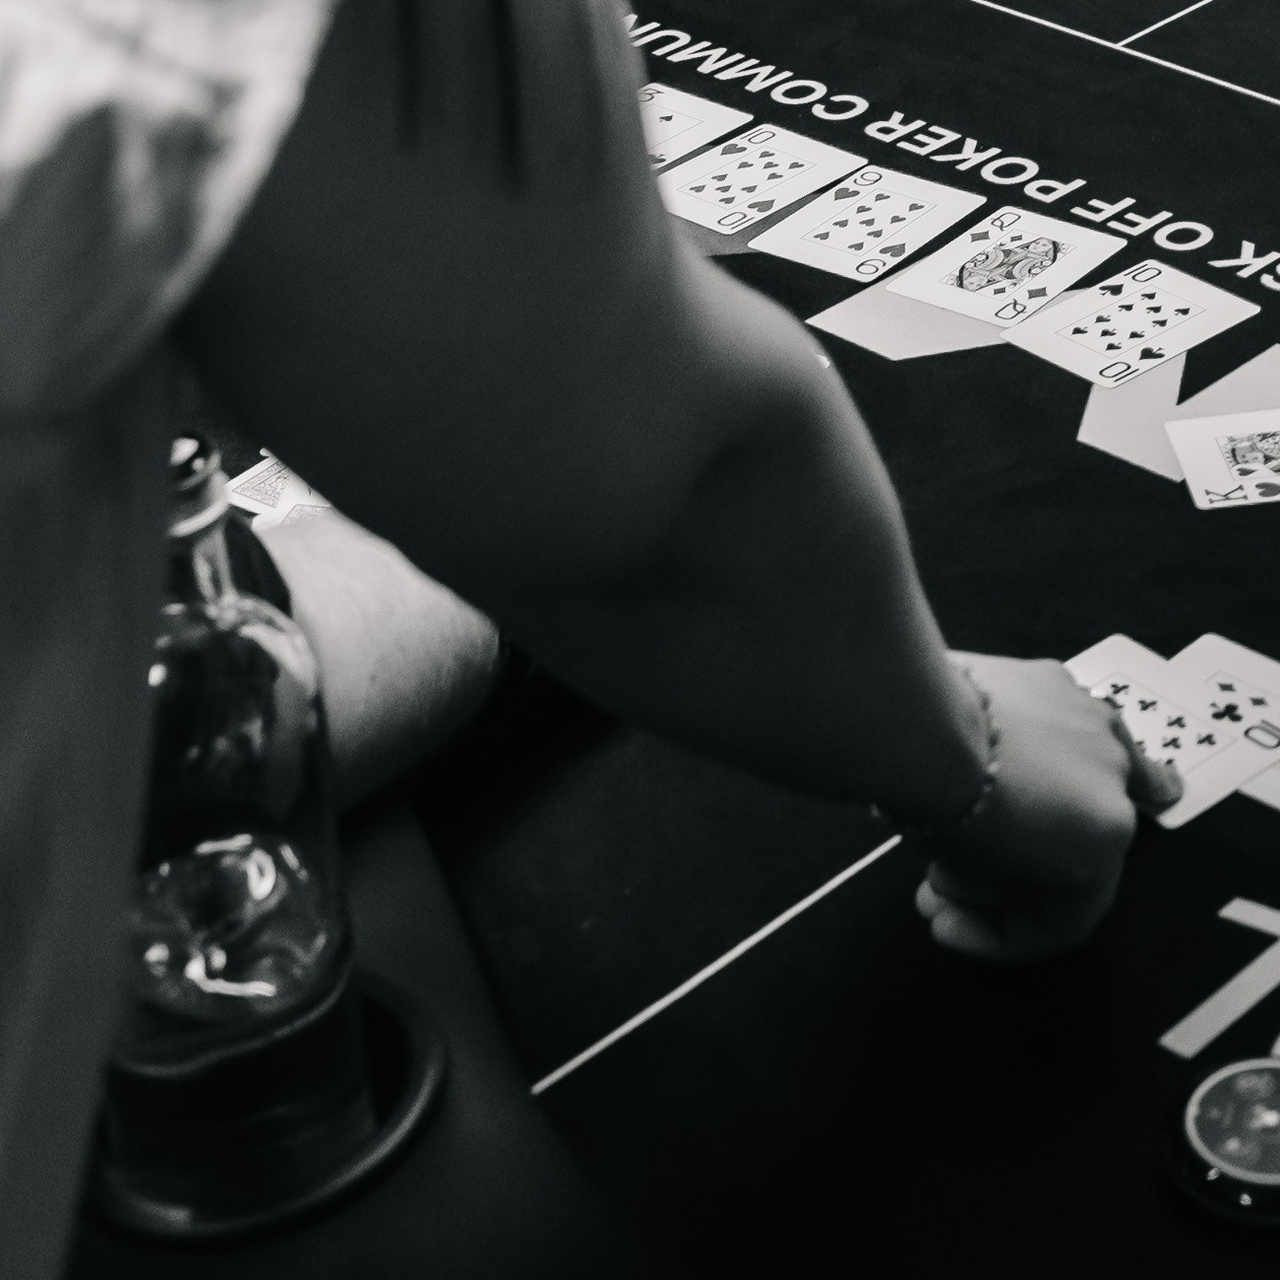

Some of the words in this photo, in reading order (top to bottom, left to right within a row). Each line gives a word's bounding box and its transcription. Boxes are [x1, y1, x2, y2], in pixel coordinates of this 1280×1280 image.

[864, 110, 1087, 203] POKER
[1070, 197, 1214, 251] OFF
[1205, 484, 1249, 504] K
